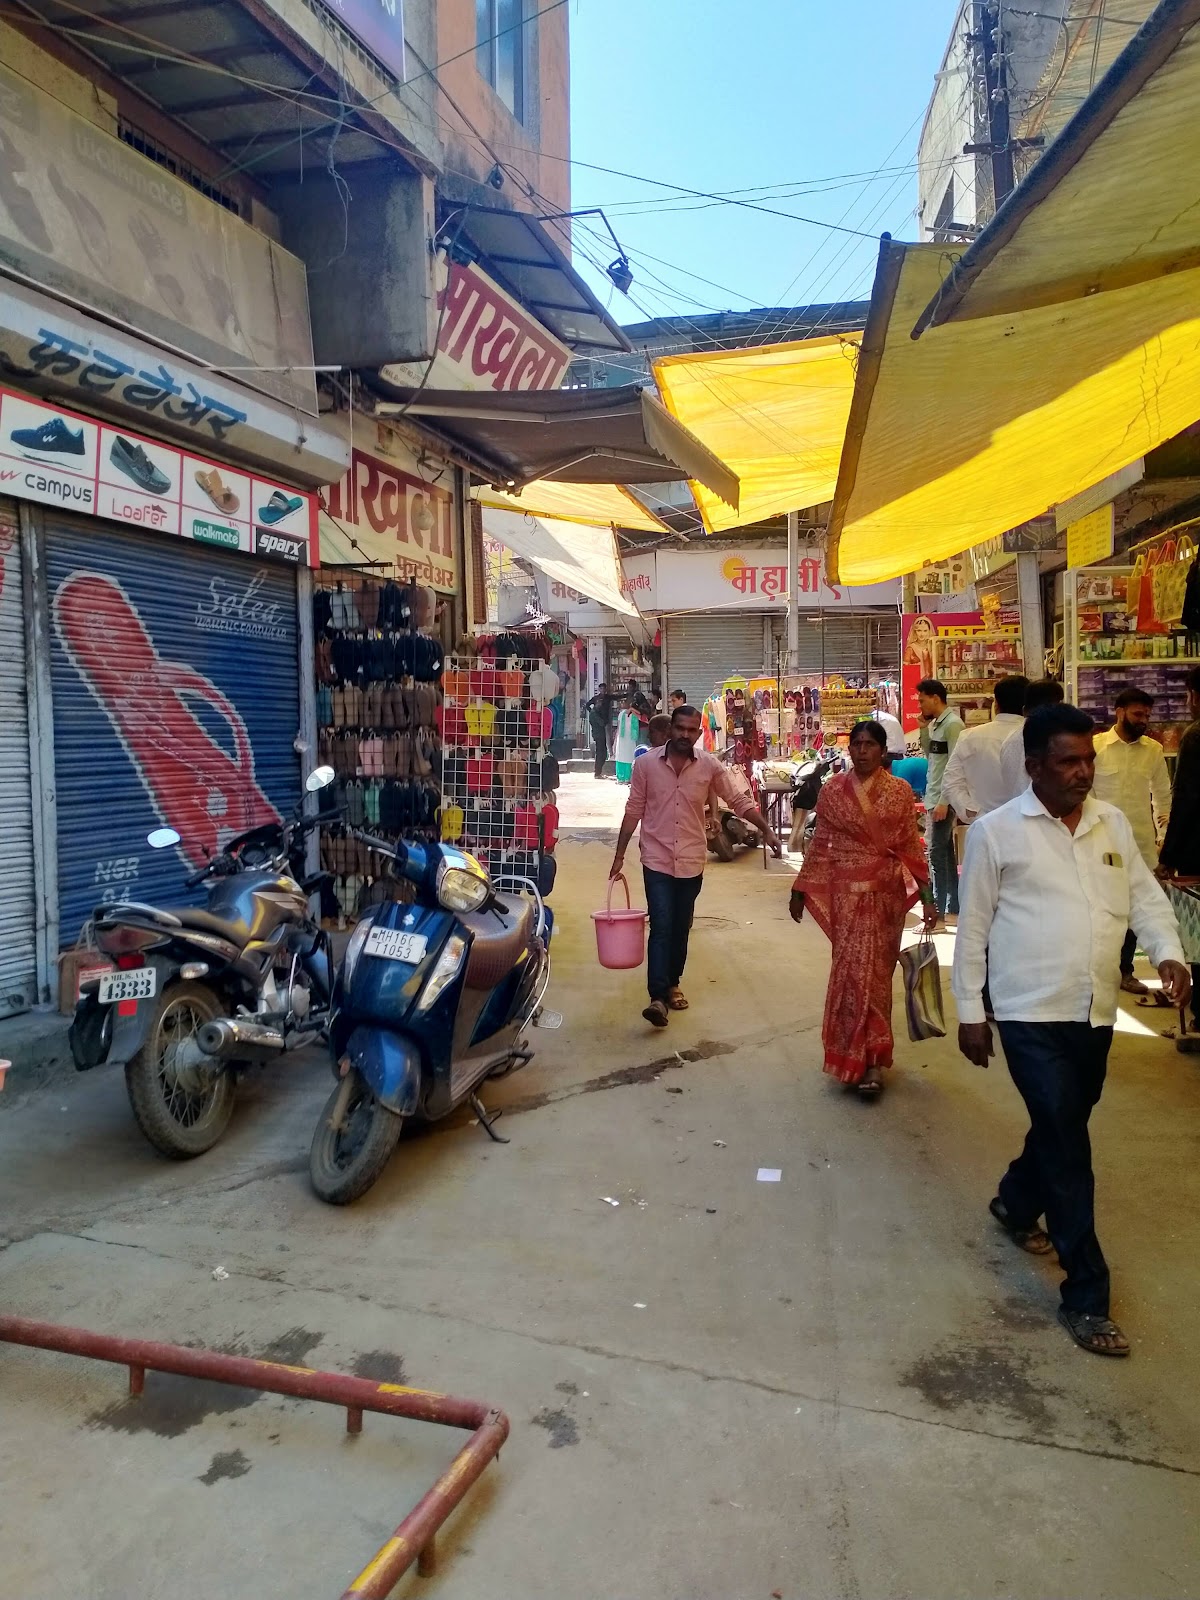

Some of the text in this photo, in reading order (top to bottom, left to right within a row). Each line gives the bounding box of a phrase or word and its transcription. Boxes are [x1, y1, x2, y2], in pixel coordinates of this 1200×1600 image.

[25, 473, 92, 503] campus
[111, 498, 168, 526] Loafer
[194, 524, 239, 545] walkmate
[258, 533, 304, 556] sparx
[375, 941, 412, 959] T1053
[102, 979, 152, 1000] 4333
